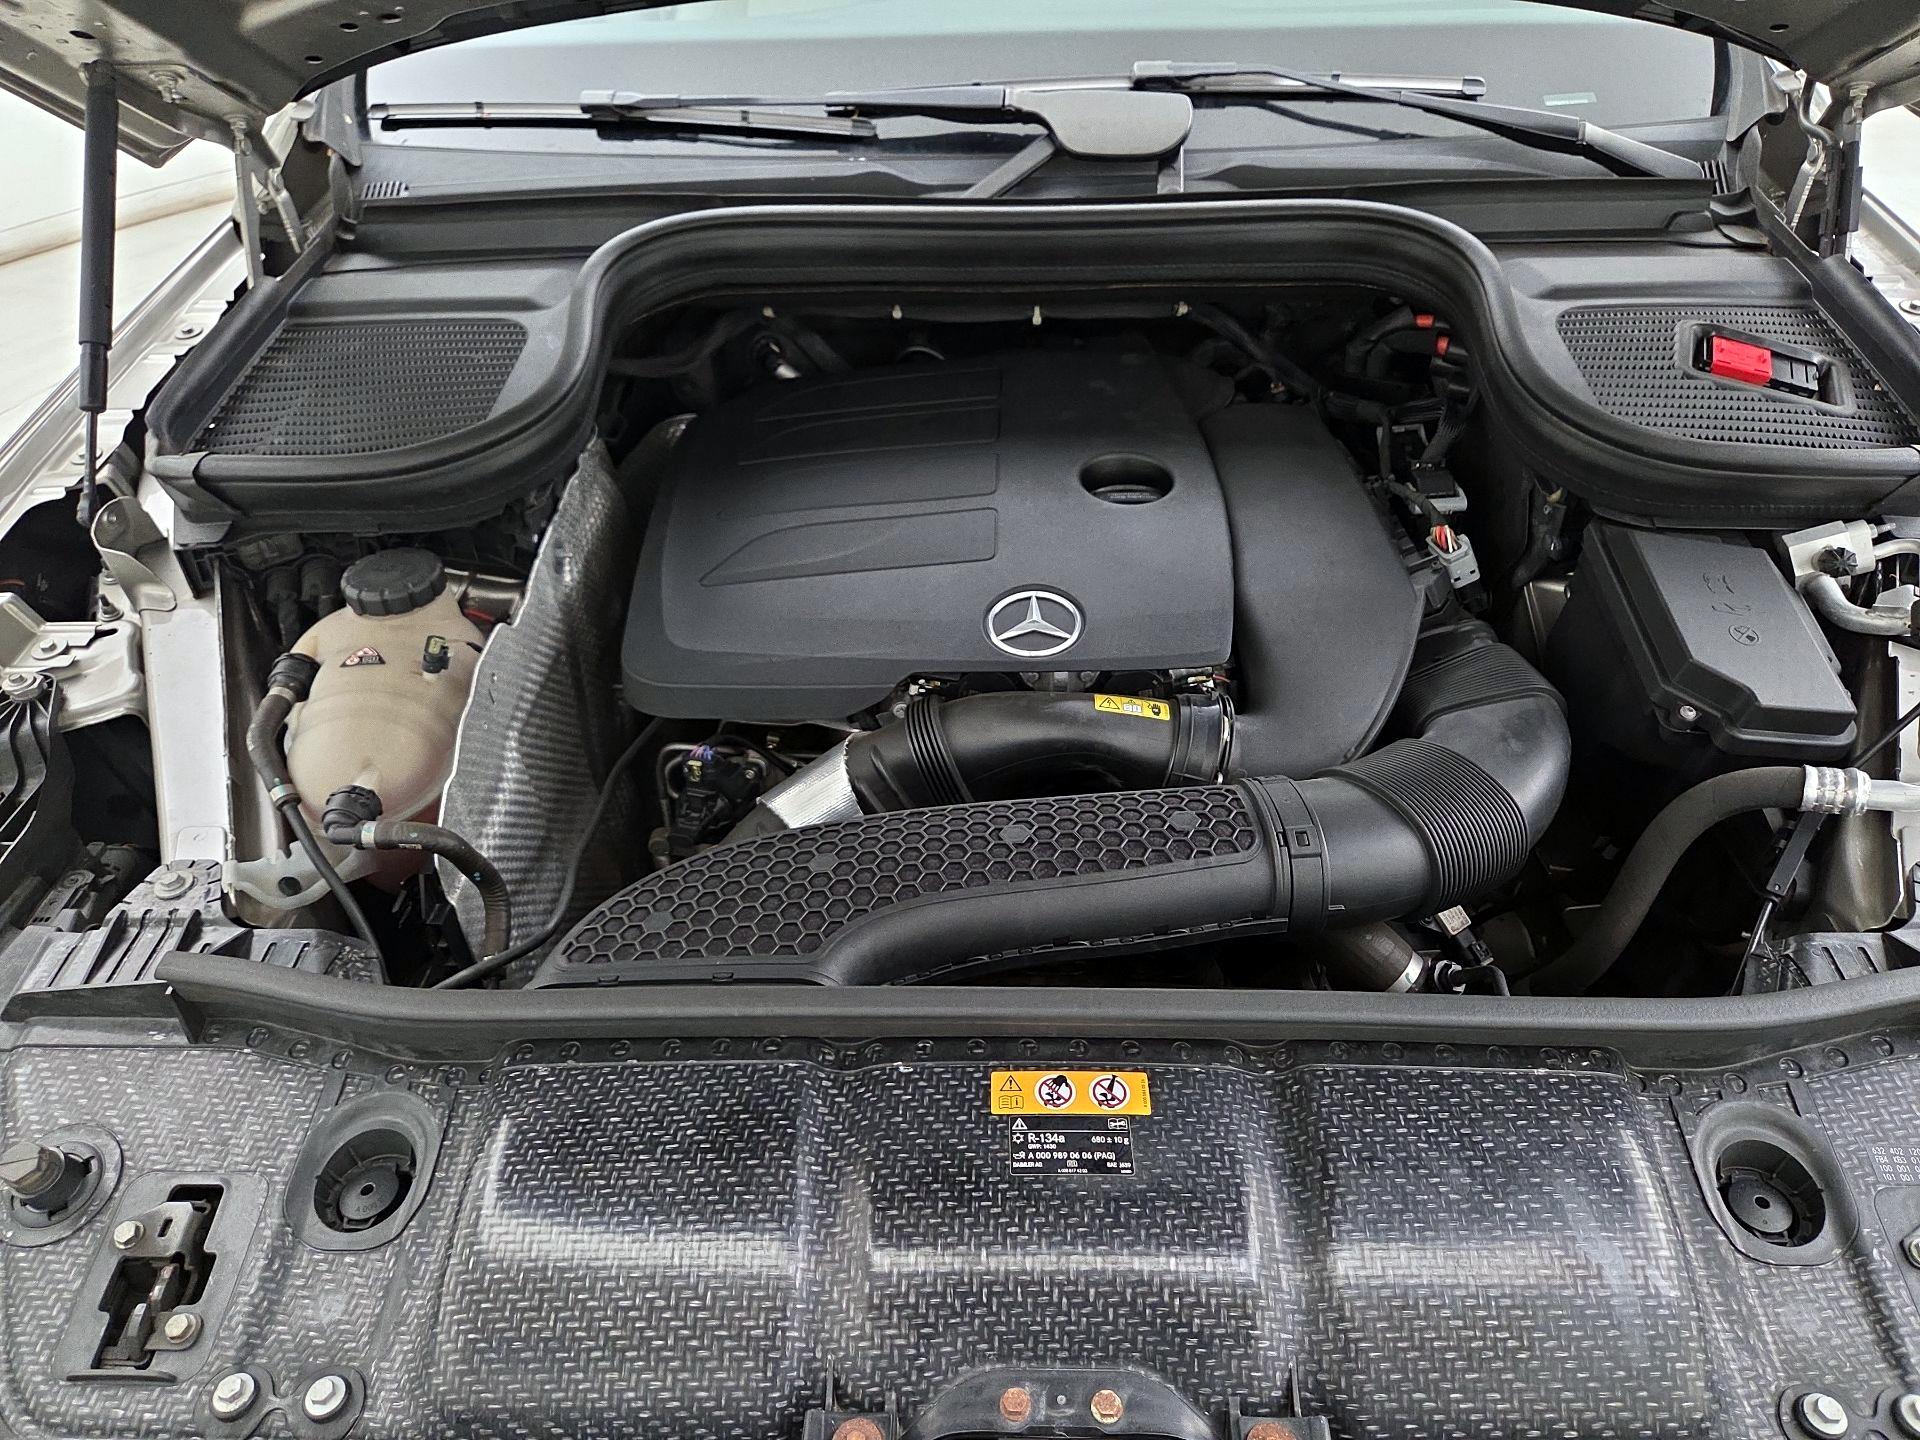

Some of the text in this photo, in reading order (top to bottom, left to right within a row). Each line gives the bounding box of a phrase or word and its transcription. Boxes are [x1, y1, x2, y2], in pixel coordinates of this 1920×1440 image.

[1028, 1132, 1066, 1144] R-134a
[1091, 1136, 1106, 1144] 680
[1028, 1152, 1116, 1161] A 000 989 06 06 (PAG)
